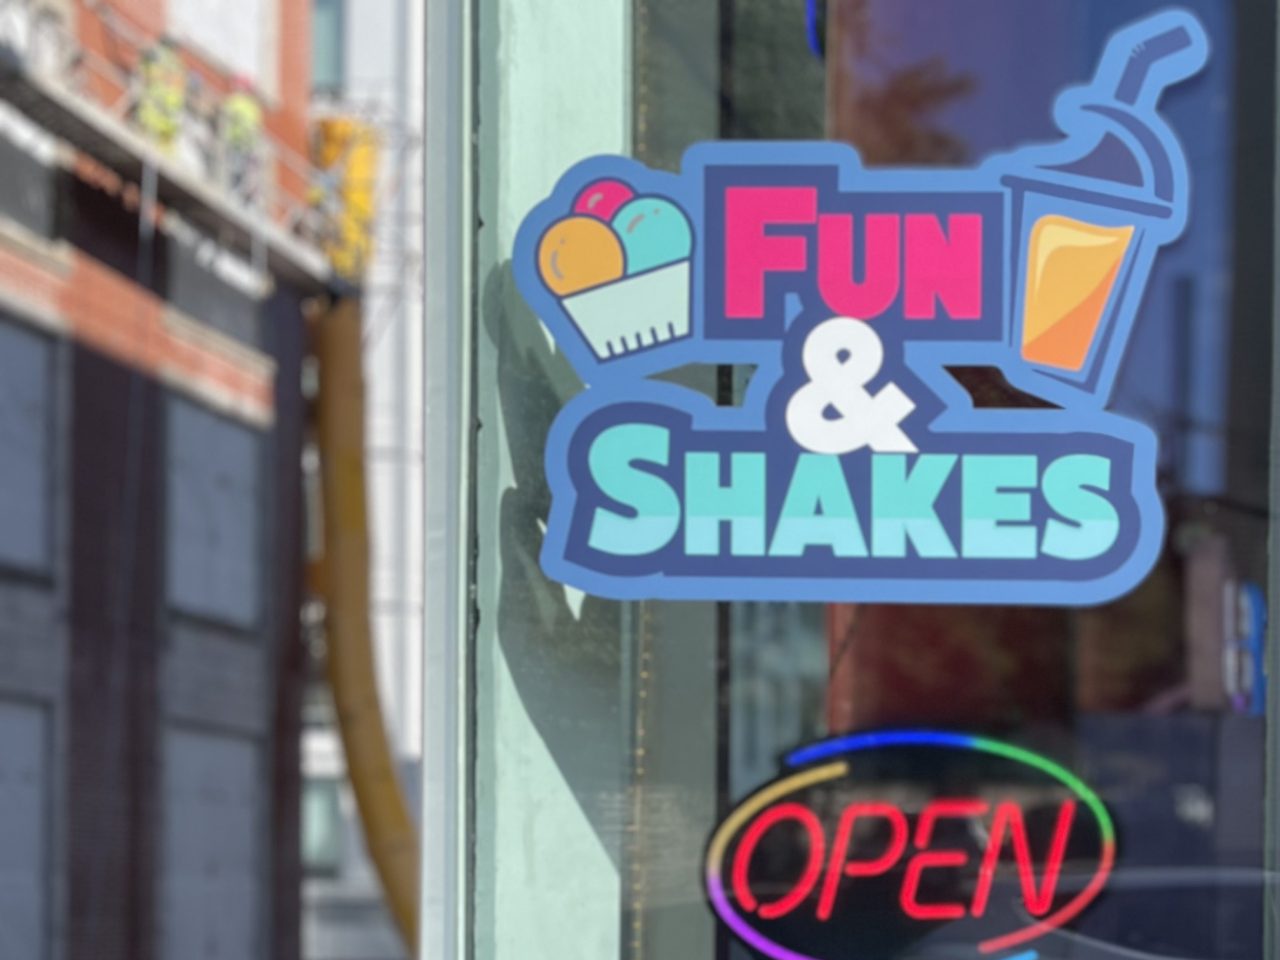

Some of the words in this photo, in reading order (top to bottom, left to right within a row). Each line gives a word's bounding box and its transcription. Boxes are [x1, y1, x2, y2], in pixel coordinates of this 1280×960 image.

[724, 187, 983, 320] FUN
[786, 317, 918, 455] &
[587, 423, 1120, 561] SHAKES
[731, 798, 1076, 921] OPEN
